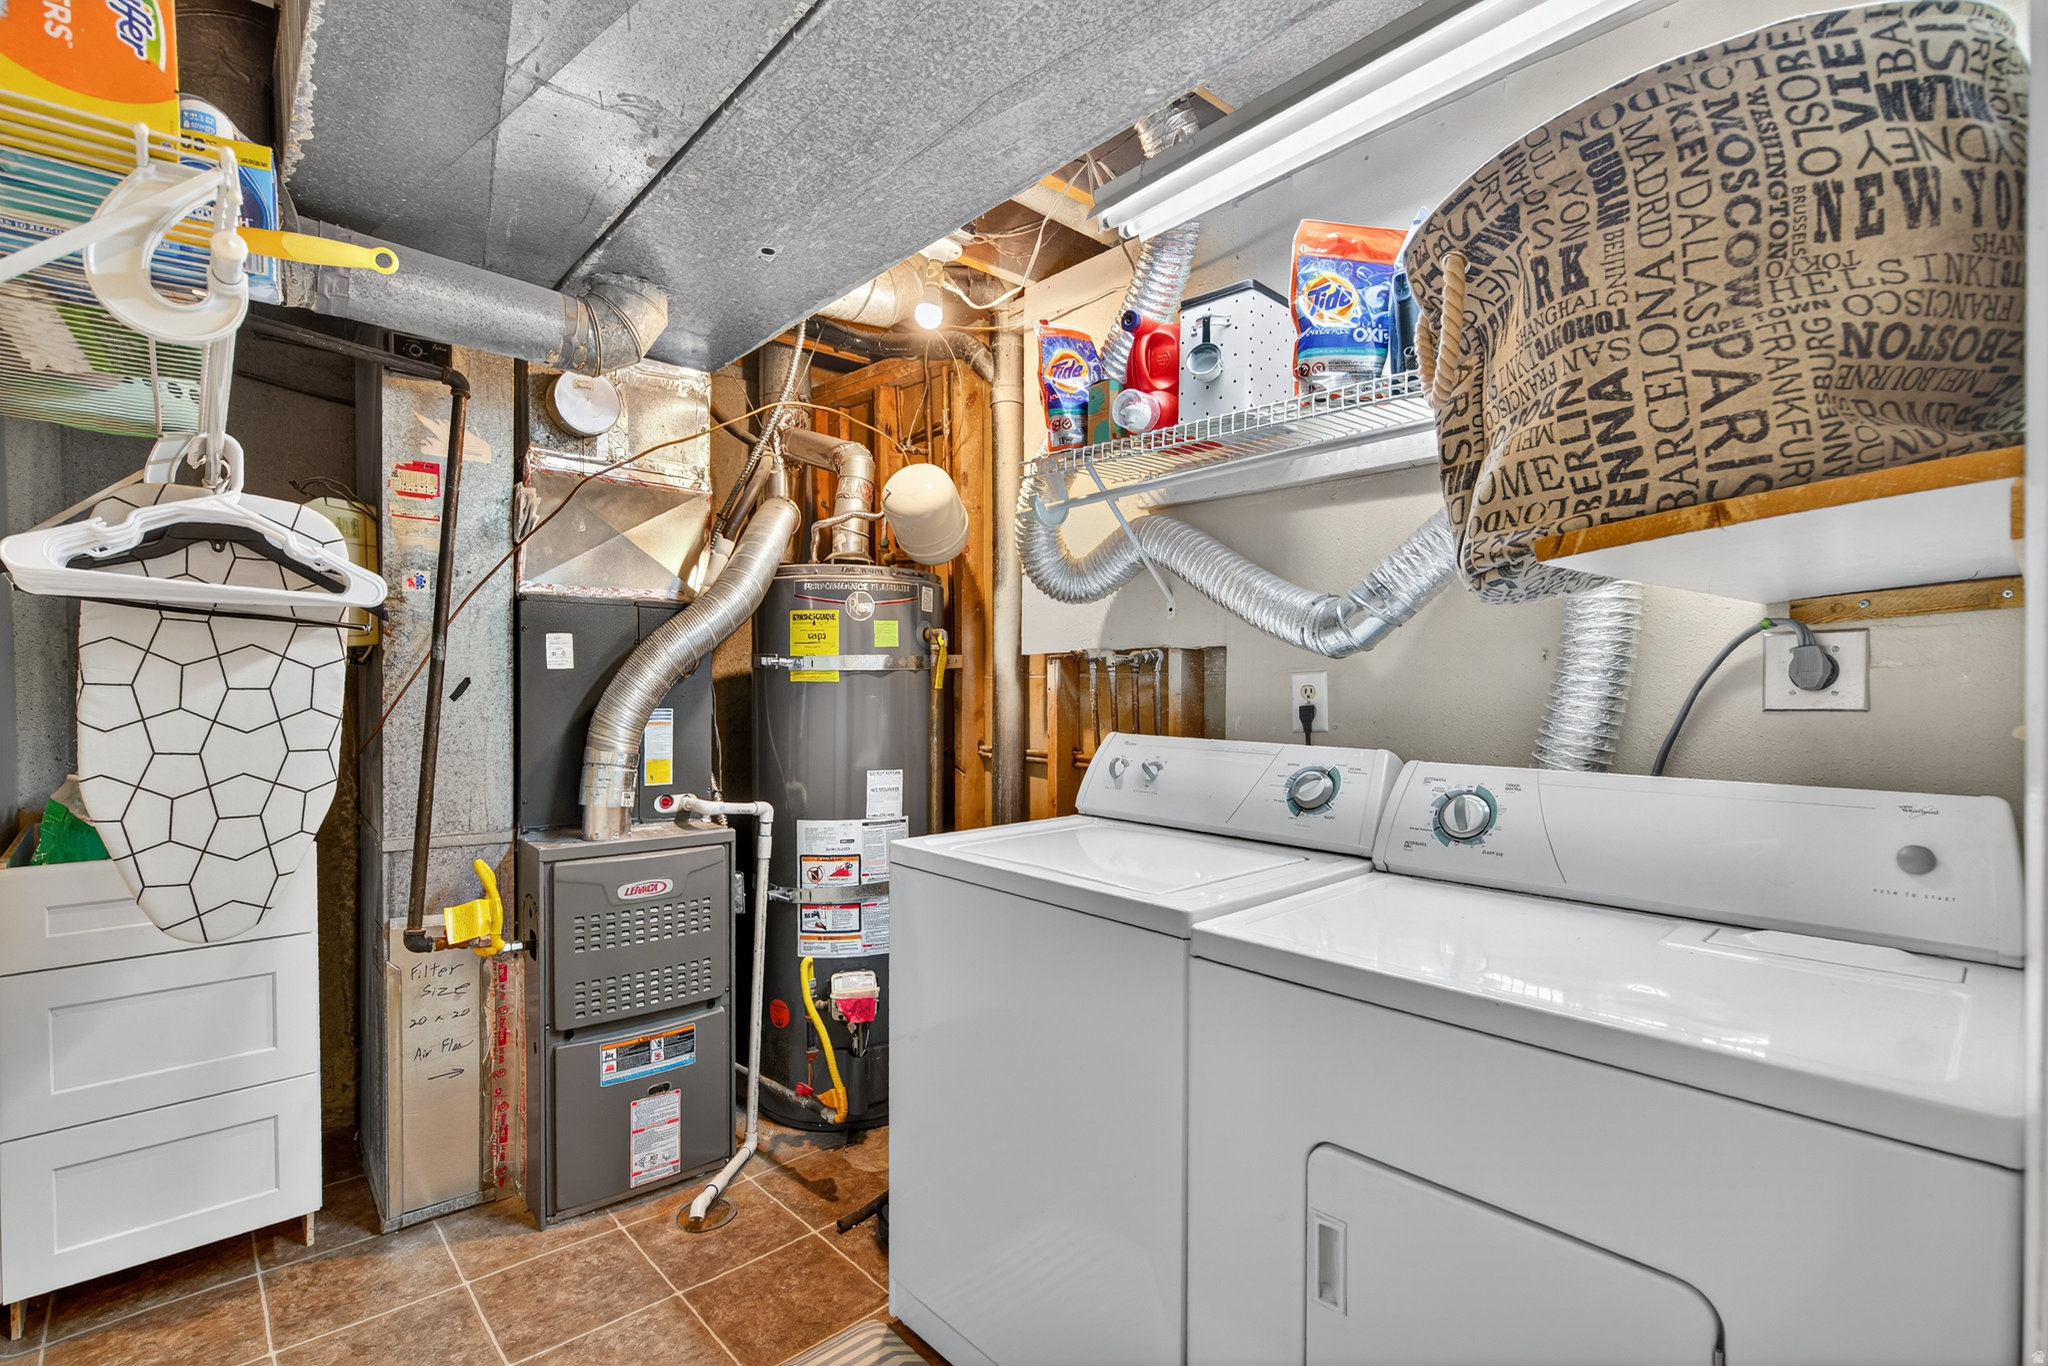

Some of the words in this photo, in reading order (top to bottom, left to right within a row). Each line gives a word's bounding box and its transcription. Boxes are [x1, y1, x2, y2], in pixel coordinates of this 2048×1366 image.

[1579, 132, 1630, 231] DUBLIN
[1619, 114, 1673, 249] MADRID
[1702, 91, 1763, 308] MOSCOW
[1746, 84, 1789, 260] WASHINGTON
[1792, 185, 1807, 257] BRUSSELS
[1603, 227, 1629, 307] BEIJING
[1675, 178, 1721, 323] DALLAS
[1686, 317, 1747, 339] CAPE
[1752, 299, 1831, 322] TOWN
[1838, 321, 2001, 364] BOSTON
[1051, 359, 1084, 379] Tide
[1635, 251, 1699, 511] BARCELONA
[1687, 328, 1774, 500] PARIS
[1556, 377, 1603, 515] BERLIN
[408, 1014, 428, 1029] 20
[453, 1006, 471, 1020] 20
[410, 961, 465, 981] Filter
